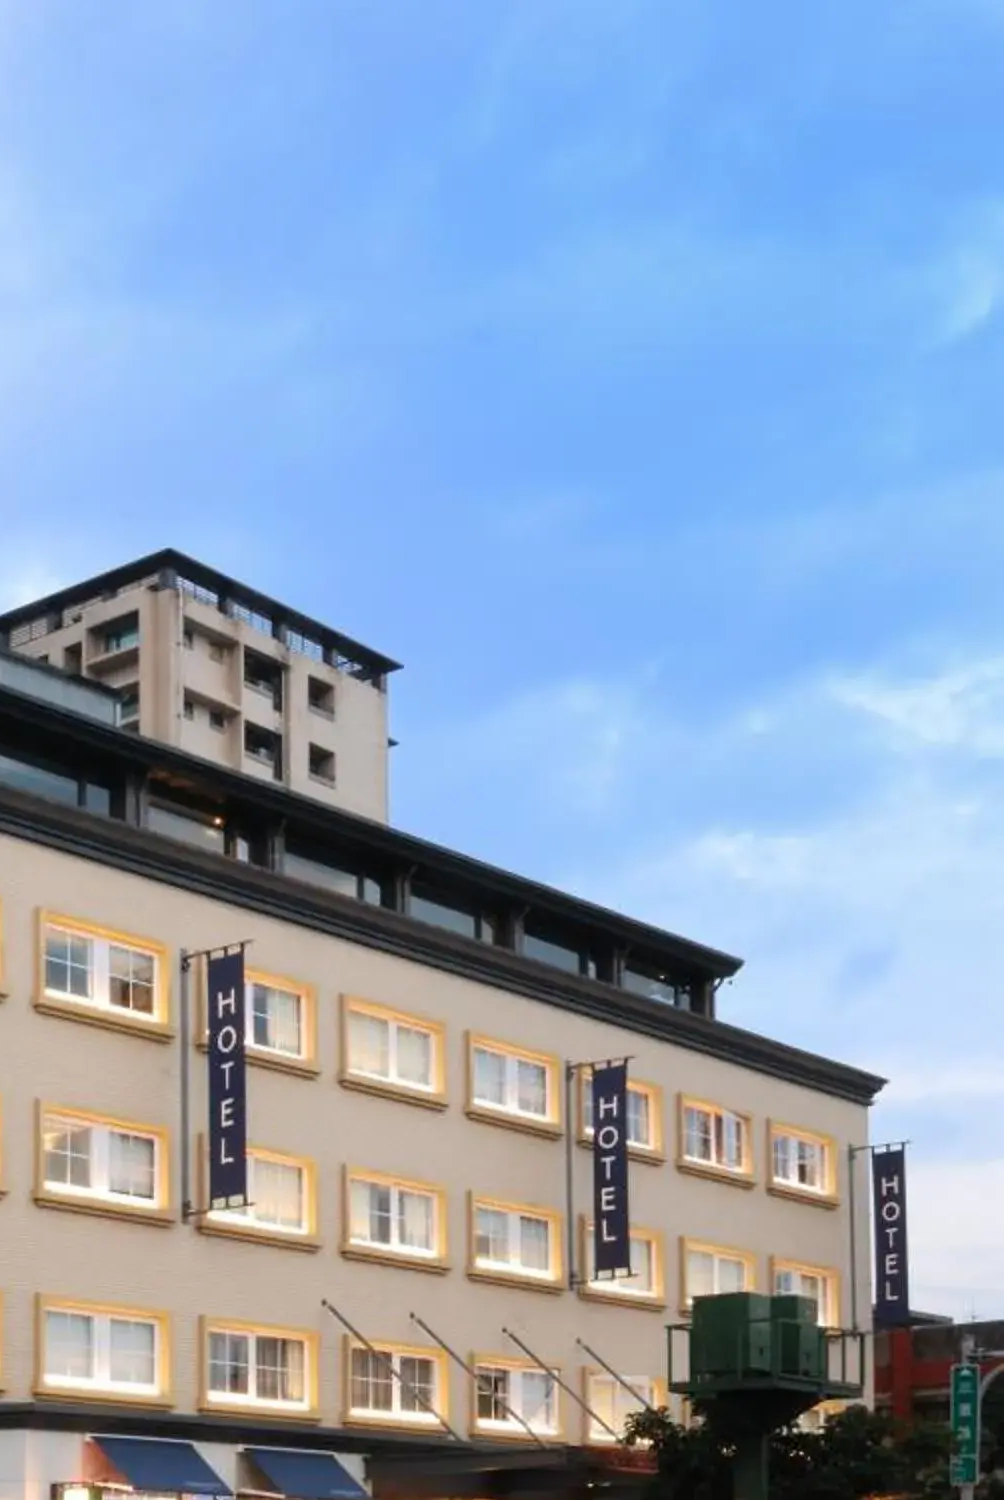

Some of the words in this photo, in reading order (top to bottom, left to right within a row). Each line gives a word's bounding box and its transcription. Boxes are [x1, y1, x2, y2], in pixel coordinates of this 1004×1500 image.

[217, 987, 237, 1165] HOTEL
[598, 1095, 619, 1242] HOTEL
[881, 1175, 901, 1301] HOTEL
